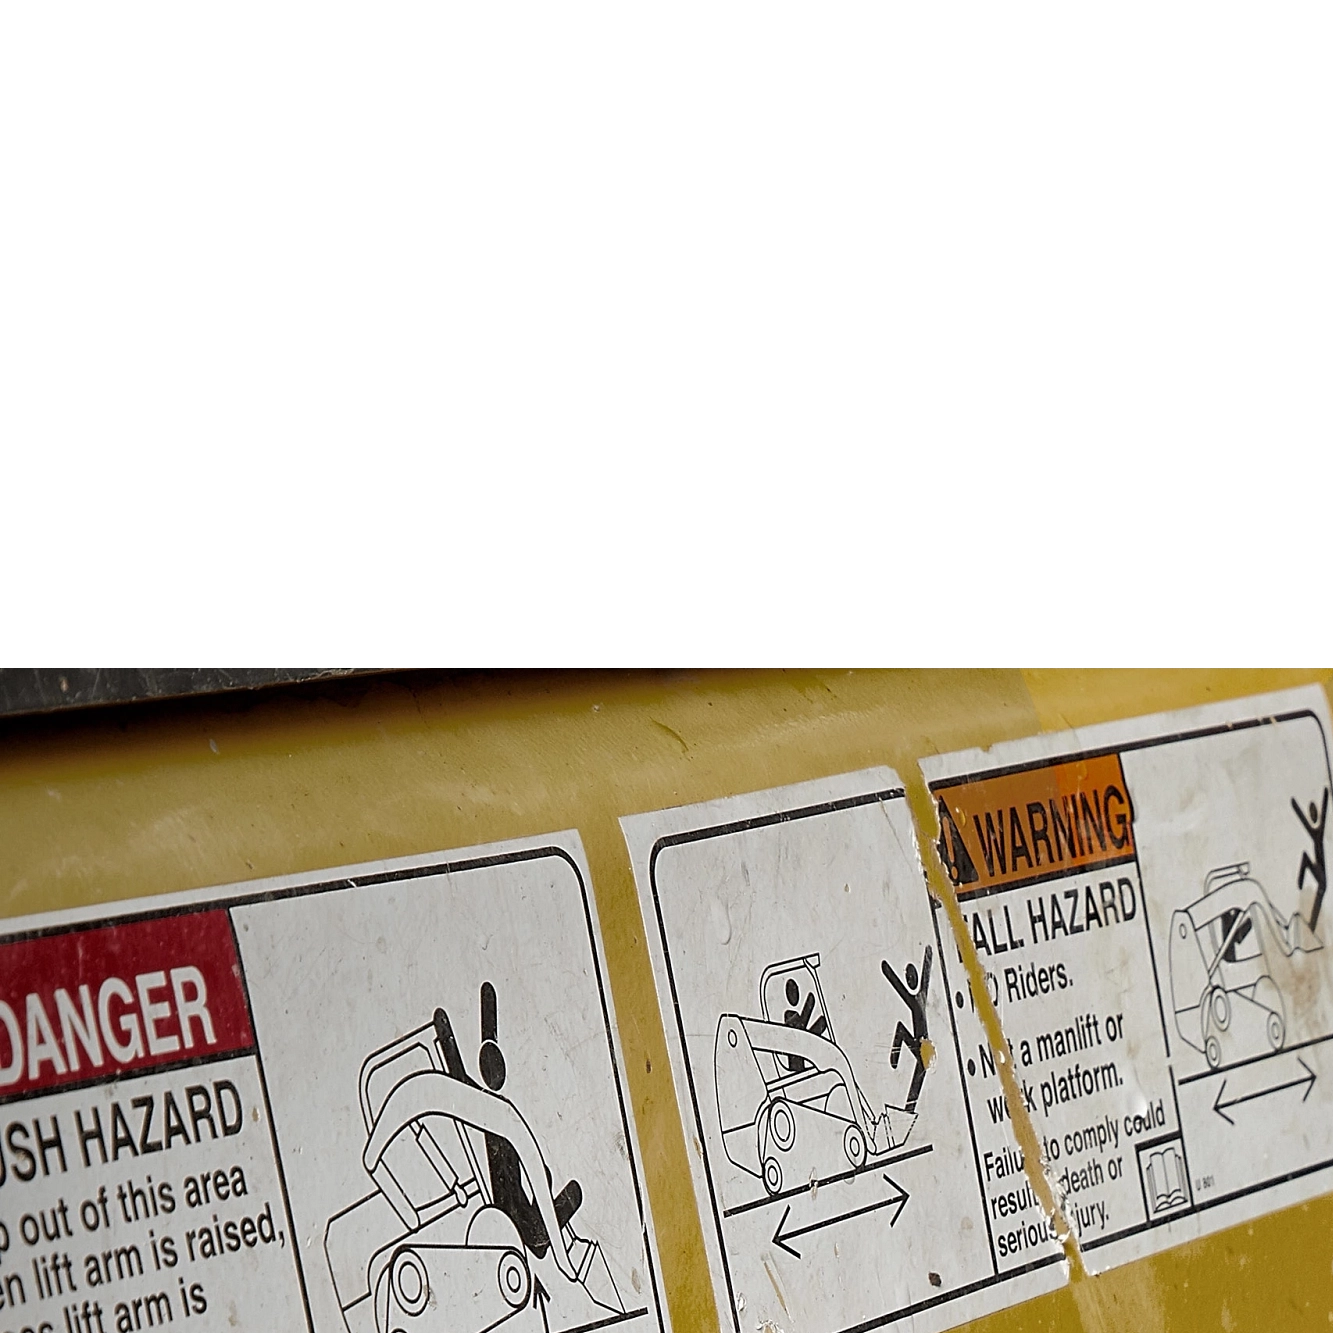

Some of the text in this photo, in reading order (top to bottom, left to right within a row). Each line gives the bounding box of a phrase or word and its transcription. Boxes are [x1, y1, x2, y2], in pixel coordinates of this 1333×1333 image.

[973, 784, 1130, 877] WARNING
[957, 876, 1136, 963] ALL HAZARD
[1004, 961, 1073, 1003] Riders.
[1020, 1039, 1033, 1068] a
[1036, 1012, 1102, 1062] manlift
[1105, 1012, 1123, 1042] or
[1040, 1061, 1123, 1117] platform.
[0, 1079, 243, 1187] SH HAZARD
[1064, 1114, 1119, 1156] comply
[1124, 1098, 1165, 1137] could
[1107, 1155, 1123, 1181] or
[19, 1197, 73, 1246] out
[80, 1185, 110, 1232] of
[117, 1175, 176, 1223] this
[183, 1164, 248, 1209] area
[31, 1252, 77, 1301] lift
[84, 1243, 144, 1287] arm
[148, 1229, 178, 1271] is
[185, 1202, 285, 1262] raised,
[178, 1276, 208, 1317] is
